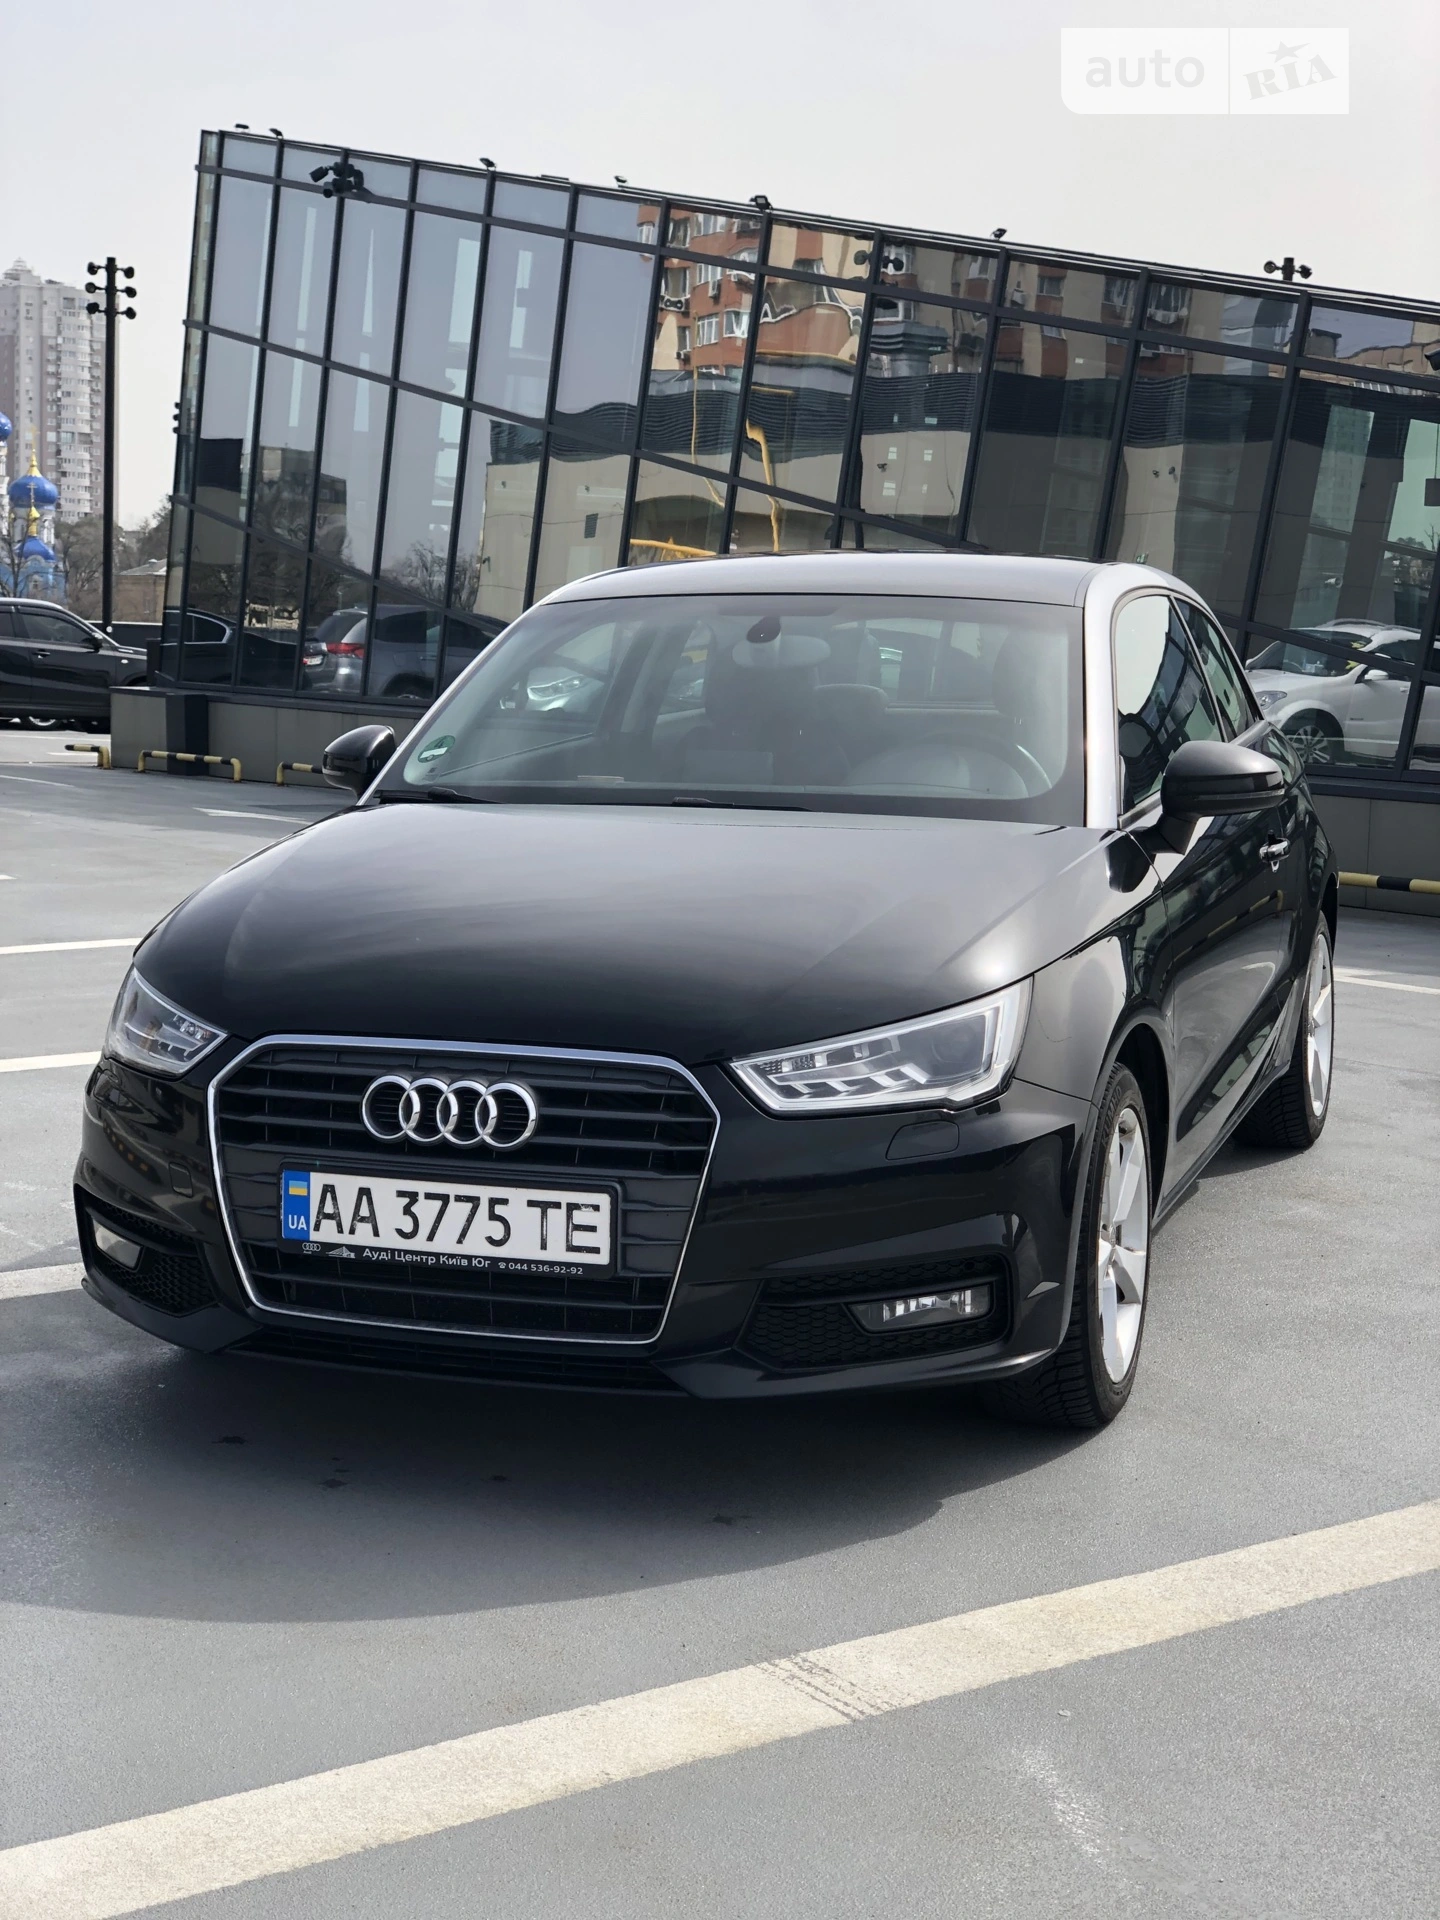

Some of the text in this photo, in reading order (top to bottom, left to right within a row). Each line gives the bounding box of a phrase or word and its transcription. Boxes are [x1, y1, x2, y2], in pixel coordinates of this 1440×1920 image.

[288, 1214, 307, 1231] UA
[313, 1184, 601, 1255] AA 3775 TE
[363, 1248, 491, 1268] Ауді Центр Київ Юг
[508, 1262, 584, 1275] 044 536-92-92
